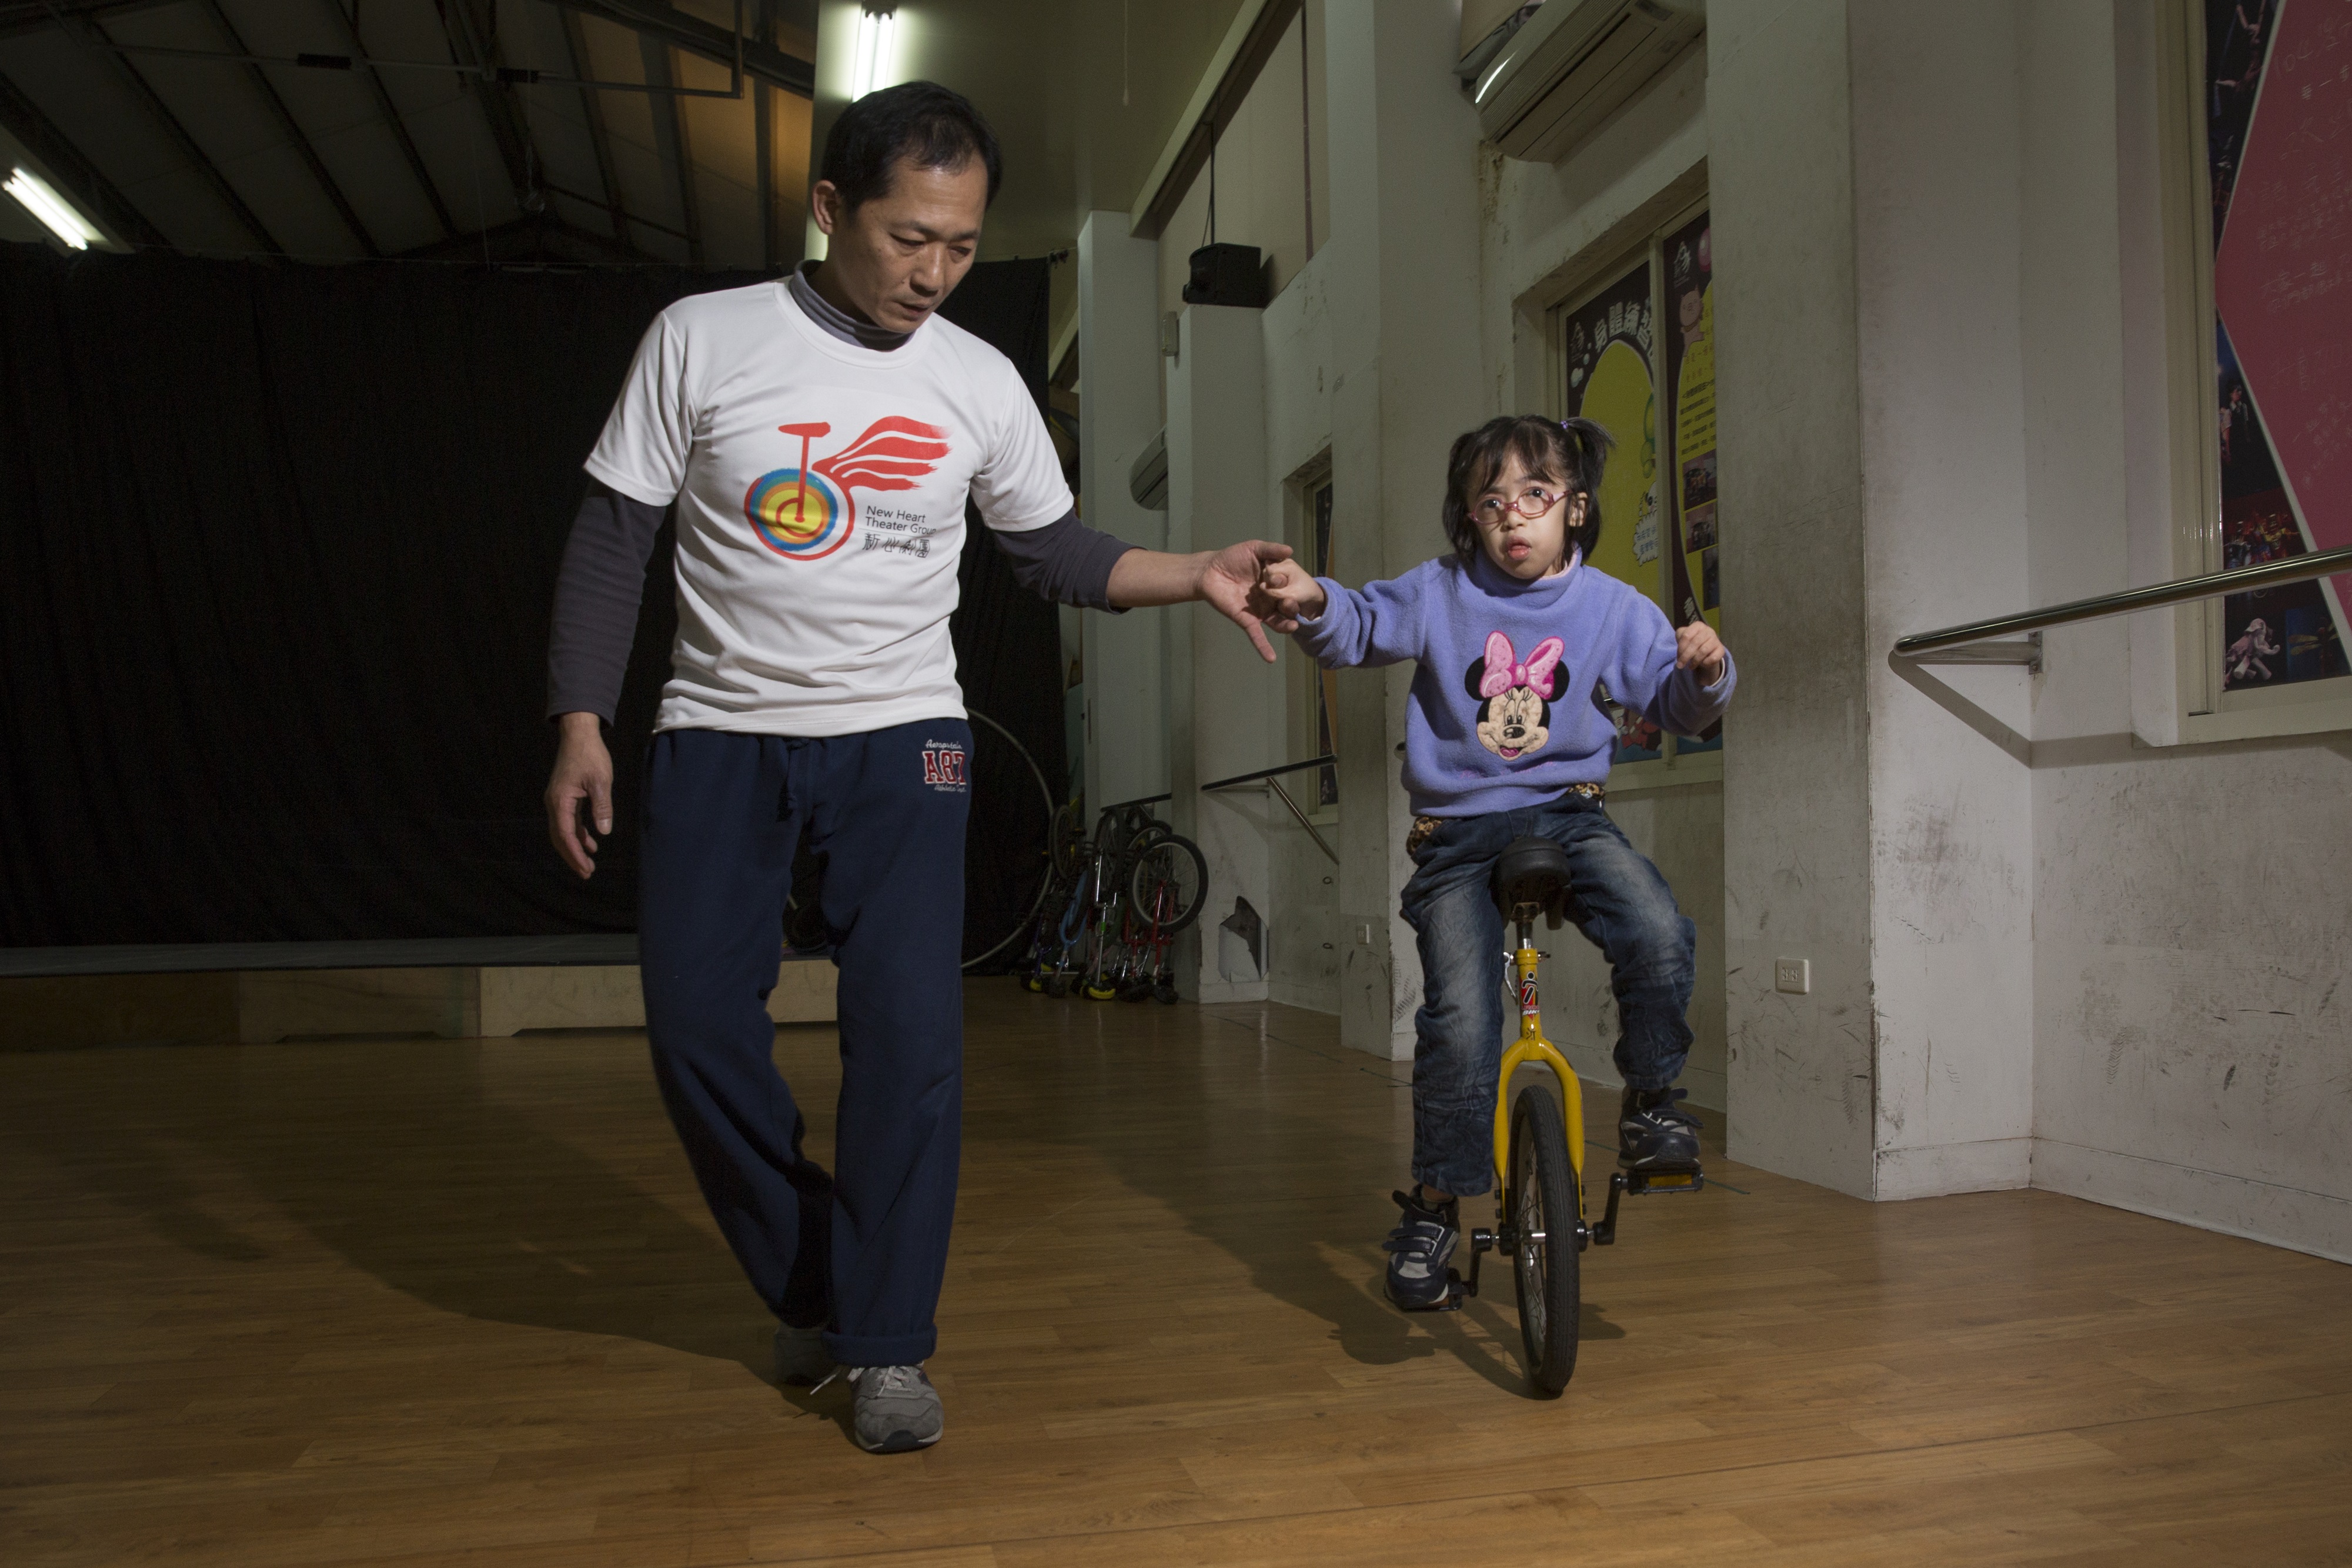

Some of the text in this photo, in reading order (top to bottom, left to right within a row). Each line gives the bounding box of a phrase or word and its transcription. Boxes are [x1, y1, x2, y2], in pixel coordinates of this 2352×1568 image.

[866, 506, 926, 523] New Heart
[866, 516, 937, 535] Theater Group
[922, 750, 967, 785] A87
